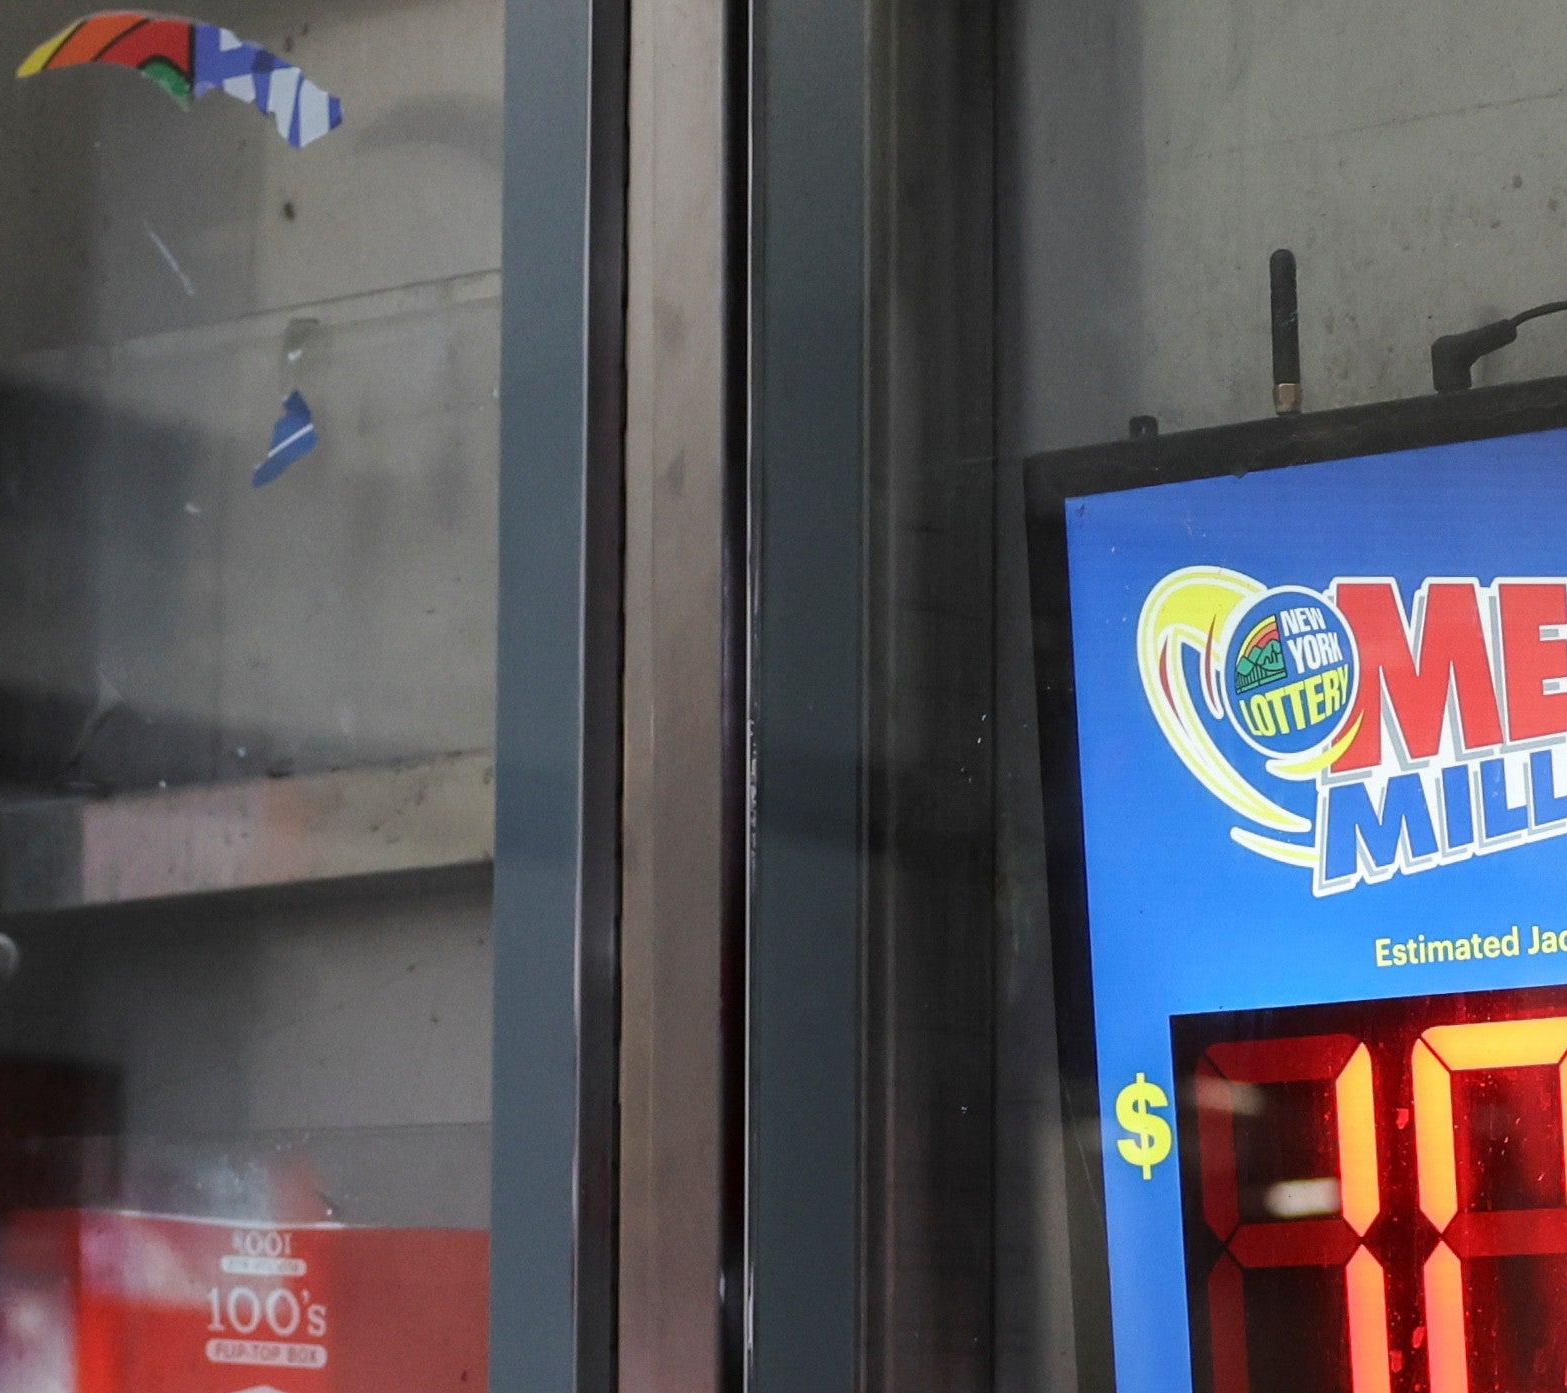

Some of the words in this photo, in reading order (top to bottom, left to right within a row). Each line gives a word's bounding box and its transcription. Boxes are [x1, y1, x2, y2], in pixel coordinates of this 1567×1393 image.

[1280, 606, 1326, 638] NEW
[1287, 632, 1344, 675] YORK
[1239, 664, 1350, 738] LOTTERY
[1375, 927, 1521, 968] Estimated
[207, 1285, 327, 1338] 100's
